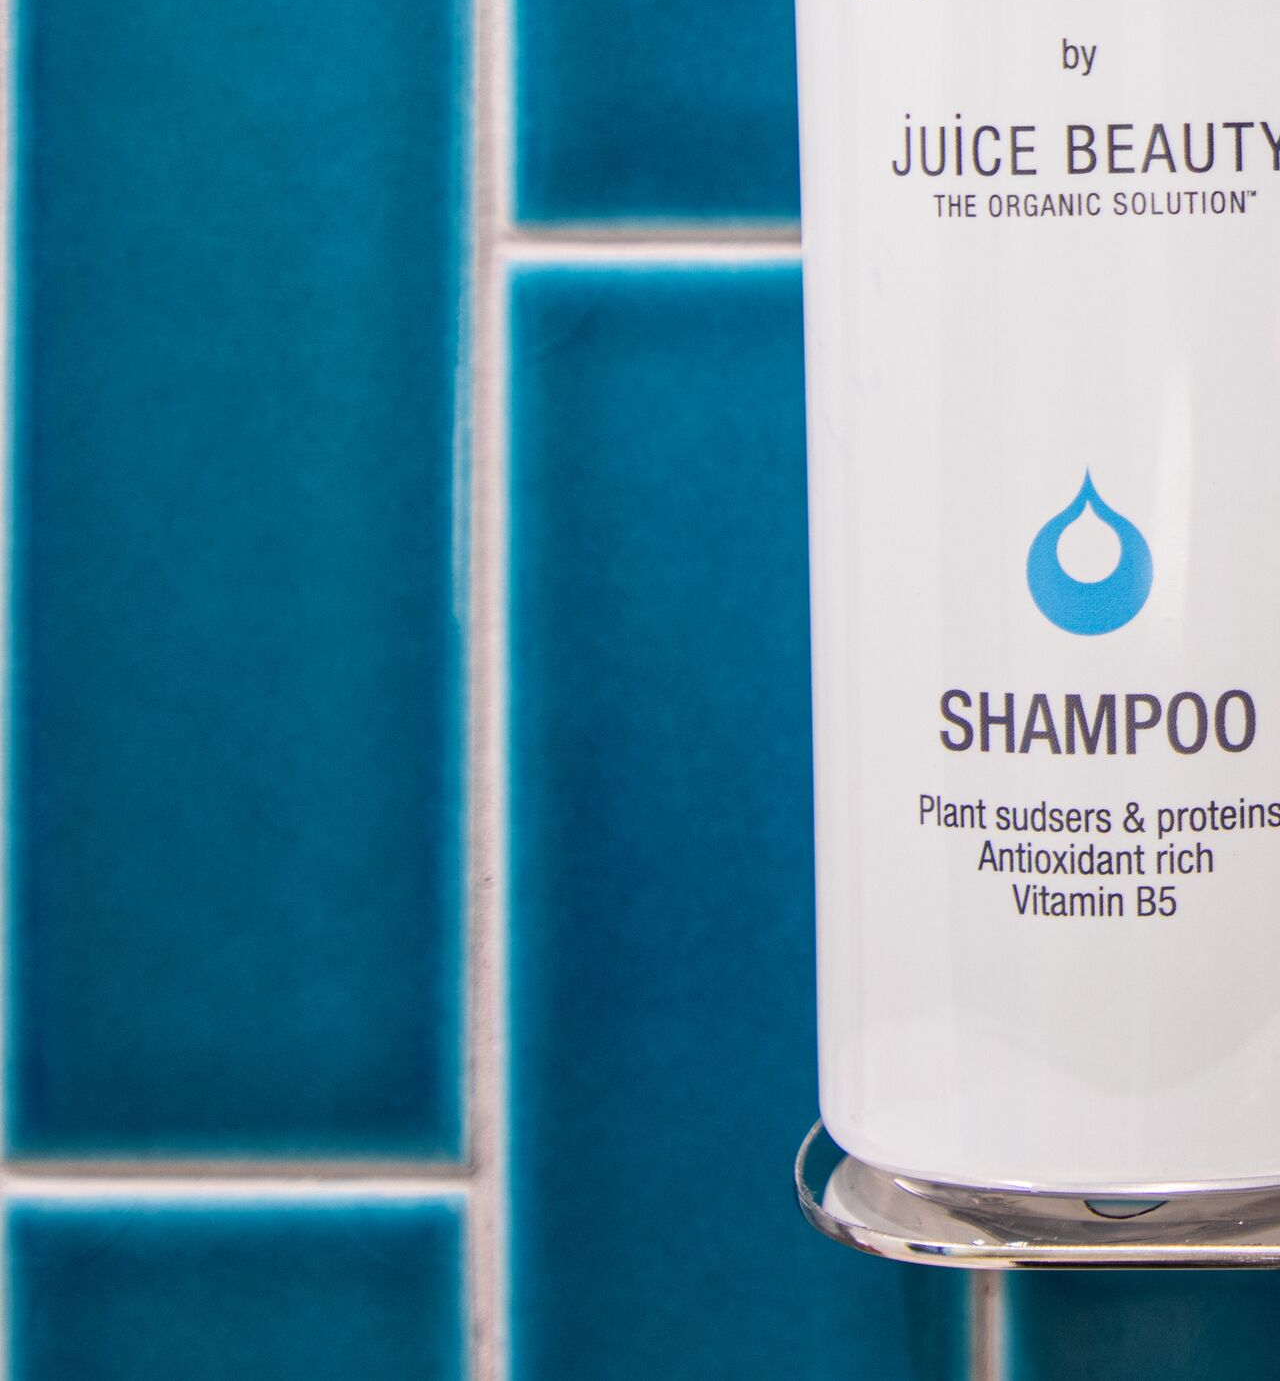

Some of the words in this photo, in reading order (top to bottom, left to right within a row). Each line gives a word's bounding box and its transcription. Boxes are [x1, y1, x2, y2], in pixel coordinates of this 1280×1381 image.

[1062, 38, 1097, 77] by
[933, 194, 977, 218] THE
[988, 192, 1101, 218] ORGANIC
[939, 688, 1257, 756] SHAMPOO
[919, 793, 987, 830] Plant
[995, 800, 1112, 835] sudsers
[1122, 801, 1146, 834] &
[977, 839, 1146, 876] Antioxidant
[1156, 841, 1214, 875] rich
[1011, 883, 1124, 918] Vitamin
[1136, 885, 1177, 918] B5
